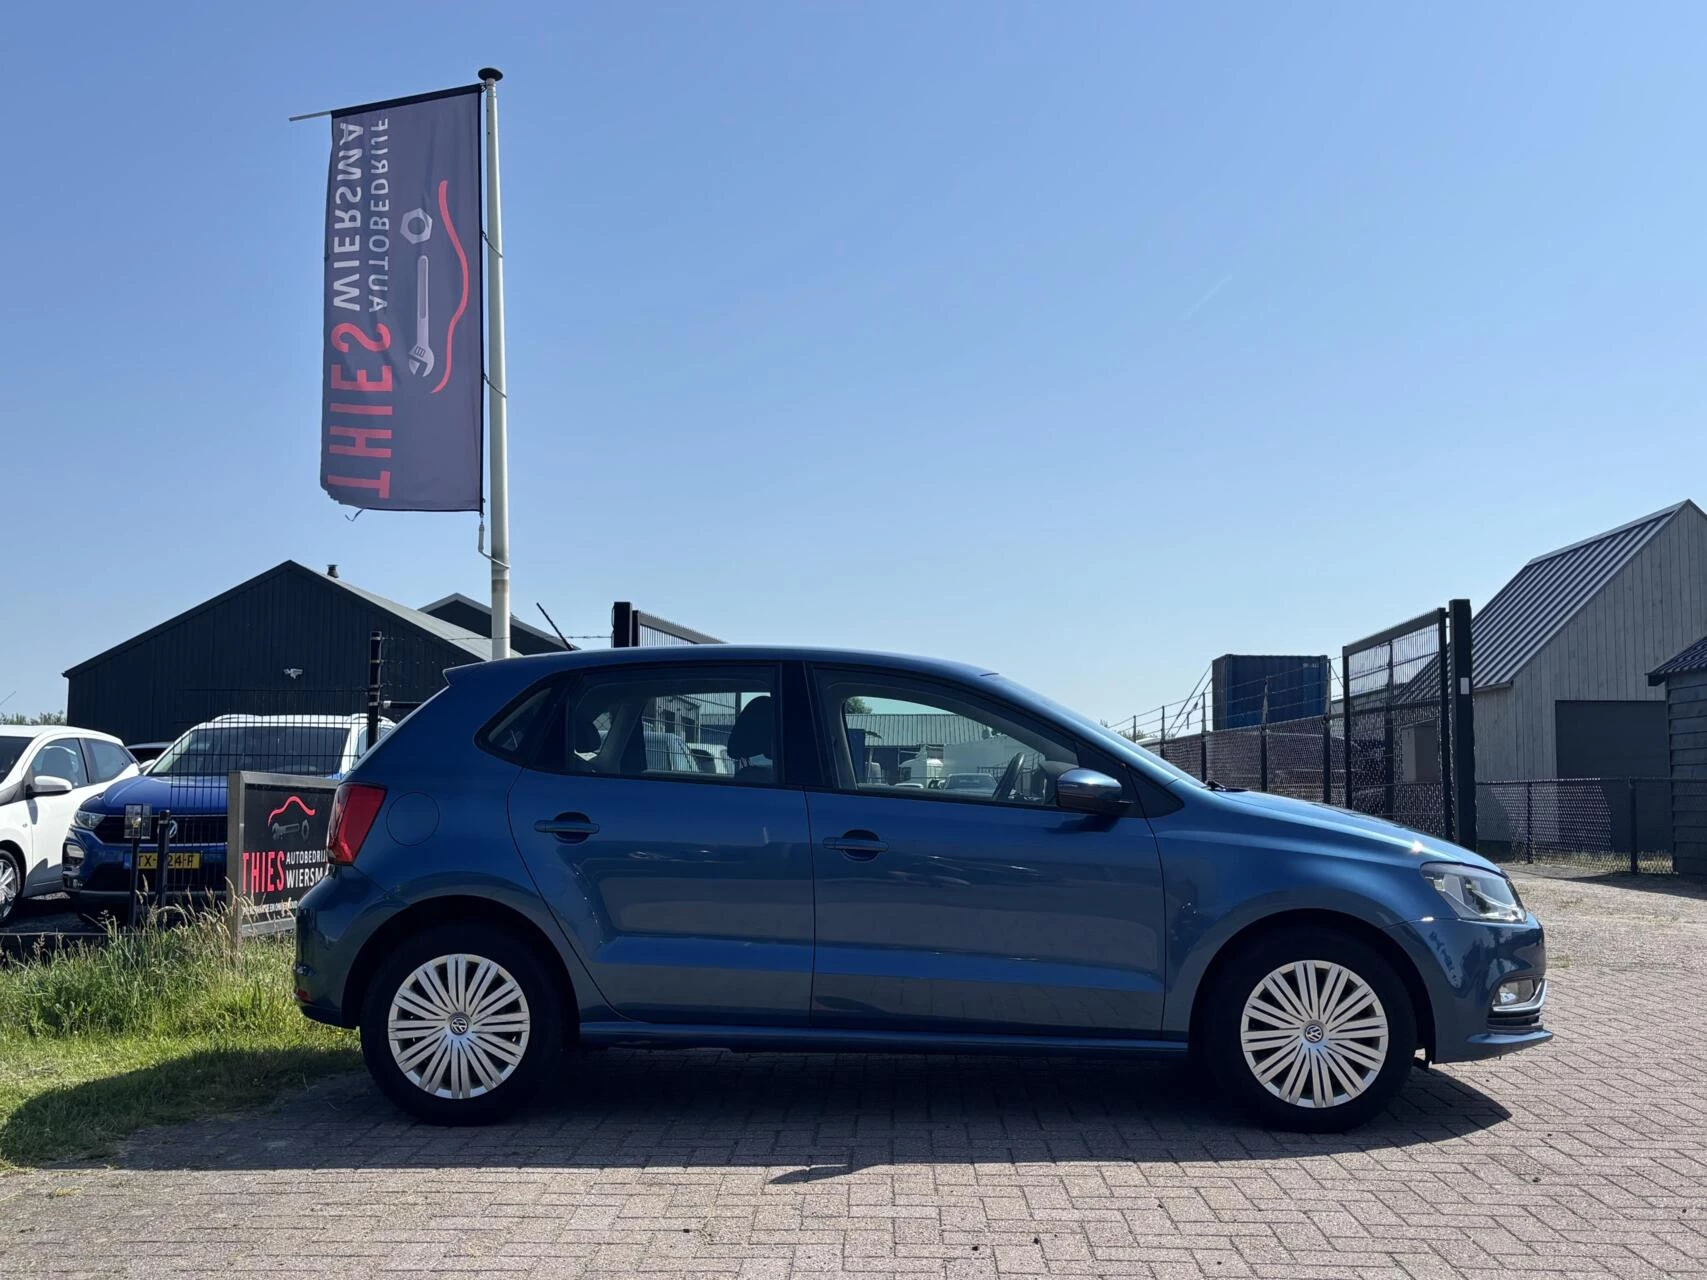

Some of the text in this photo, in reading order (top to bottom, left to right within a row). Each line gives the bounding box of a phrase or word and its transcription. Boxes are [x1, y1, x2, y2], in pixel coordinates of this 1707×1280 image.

[285, 850, 329, 865] AUTOBEDRIJ
[242, 851, 285, 894] THIES
[286, 867, 325, 889] WIERSM
